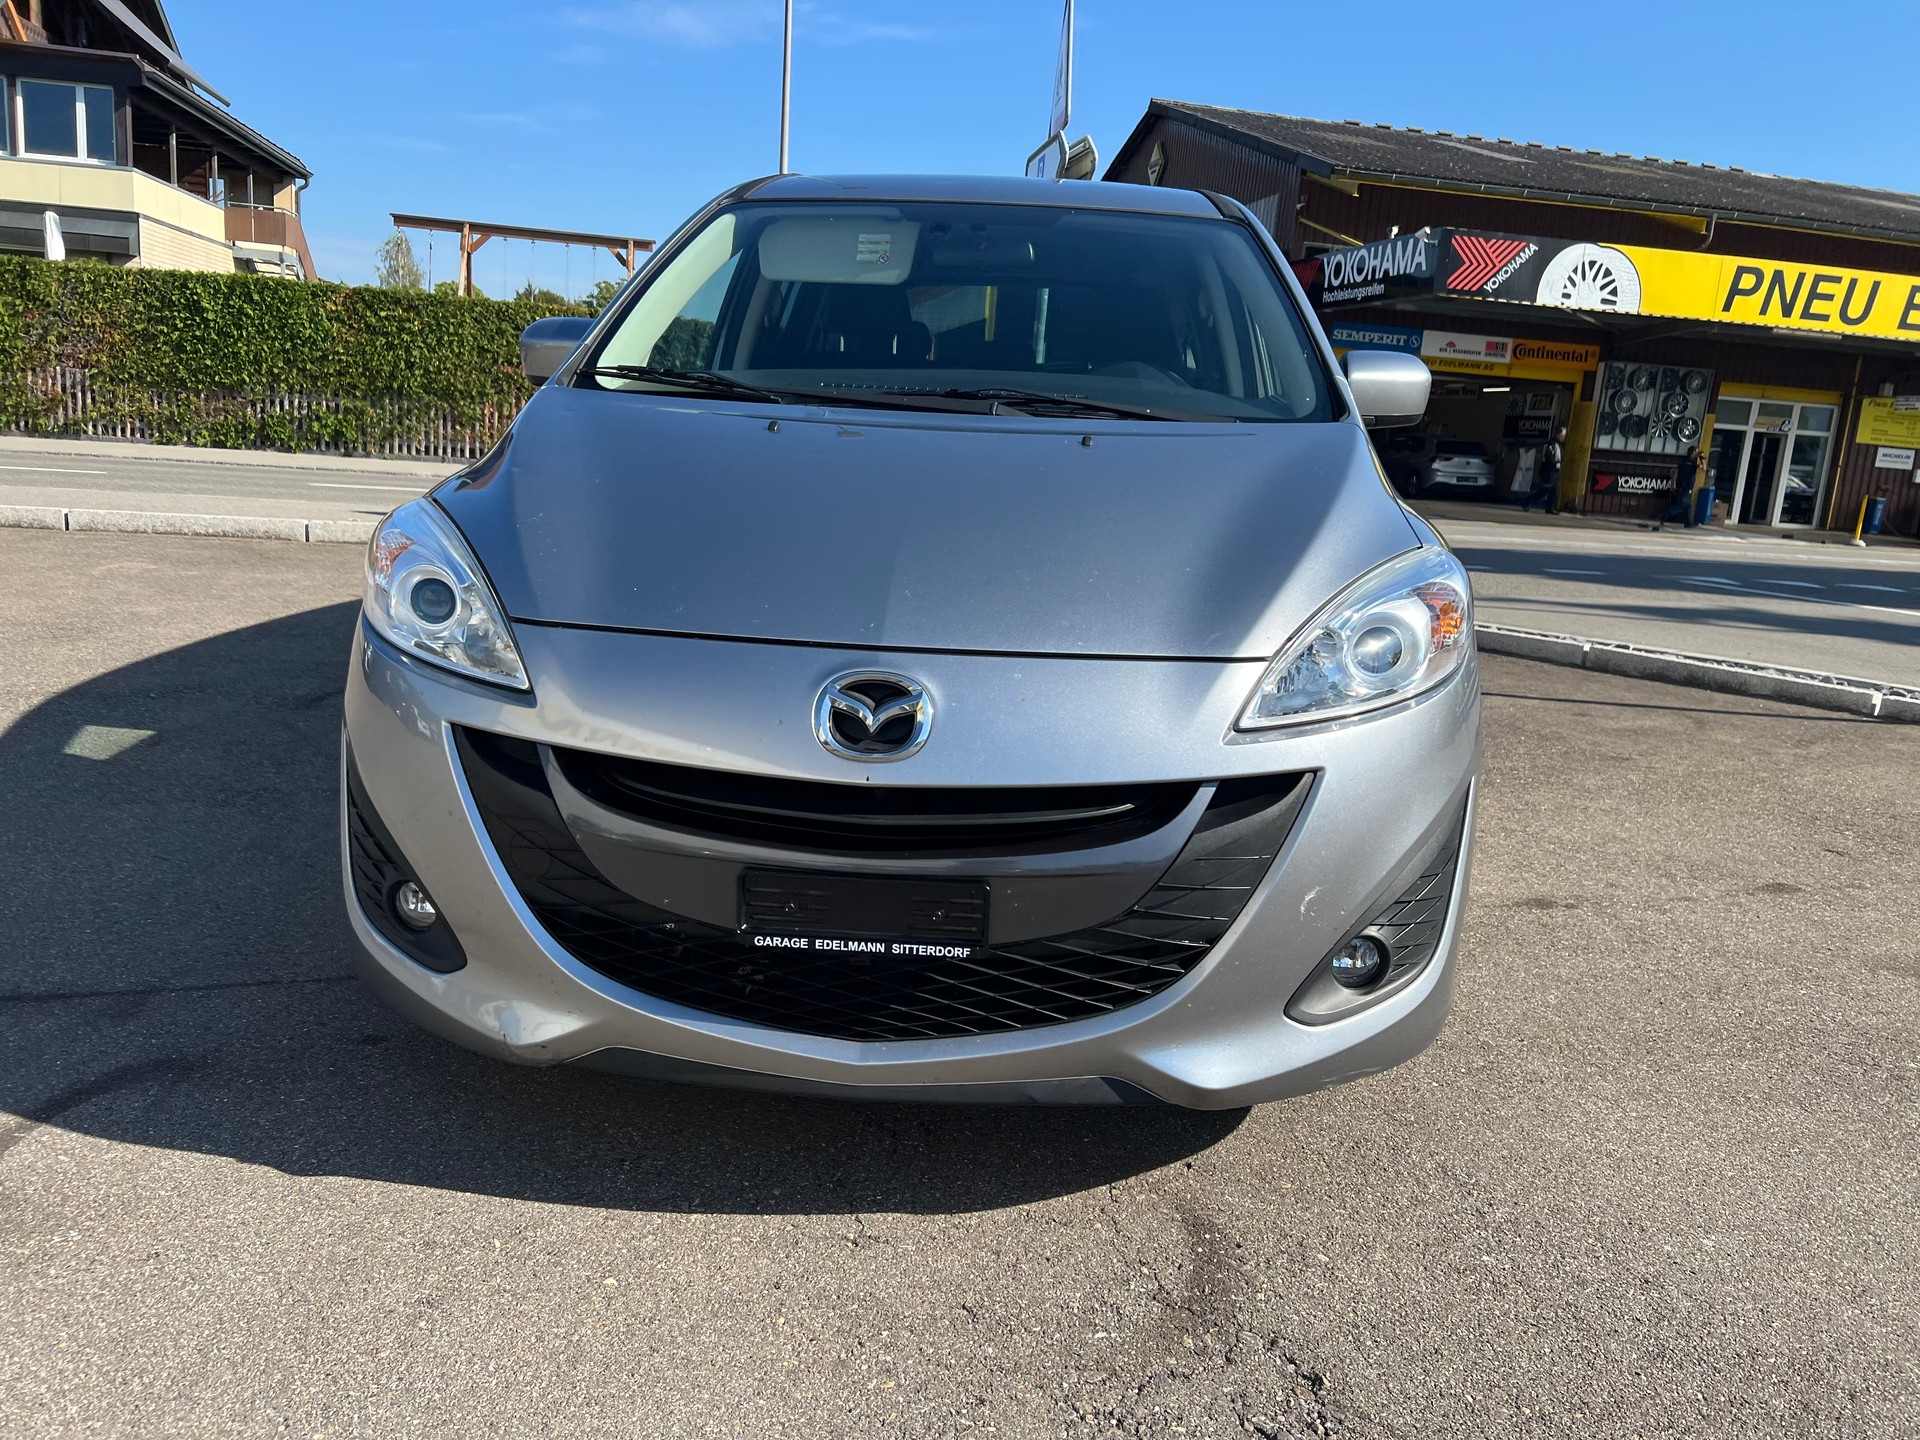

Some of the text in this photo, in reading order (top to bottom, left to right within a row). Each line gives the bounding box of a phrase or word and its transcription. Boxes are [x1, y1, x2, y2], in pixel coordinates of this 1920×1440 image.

[1323, 238, 1427, 288] YOKOHAMA
[1483, 242, 1539, 293] YOKOHAMA
[1322, 282, 1385, 303] Hochleistungsreifen
[1721, 265, 1881, 326] PNEU
[1332, 328, 1407, 346] SEMPERIT
[1513, 343, 1589, 363] Continental
[1881, 452, 1912, 460] MICHELIN
[754, 935, 971, 959] GARAGE EDELMANN SITTERDORF
